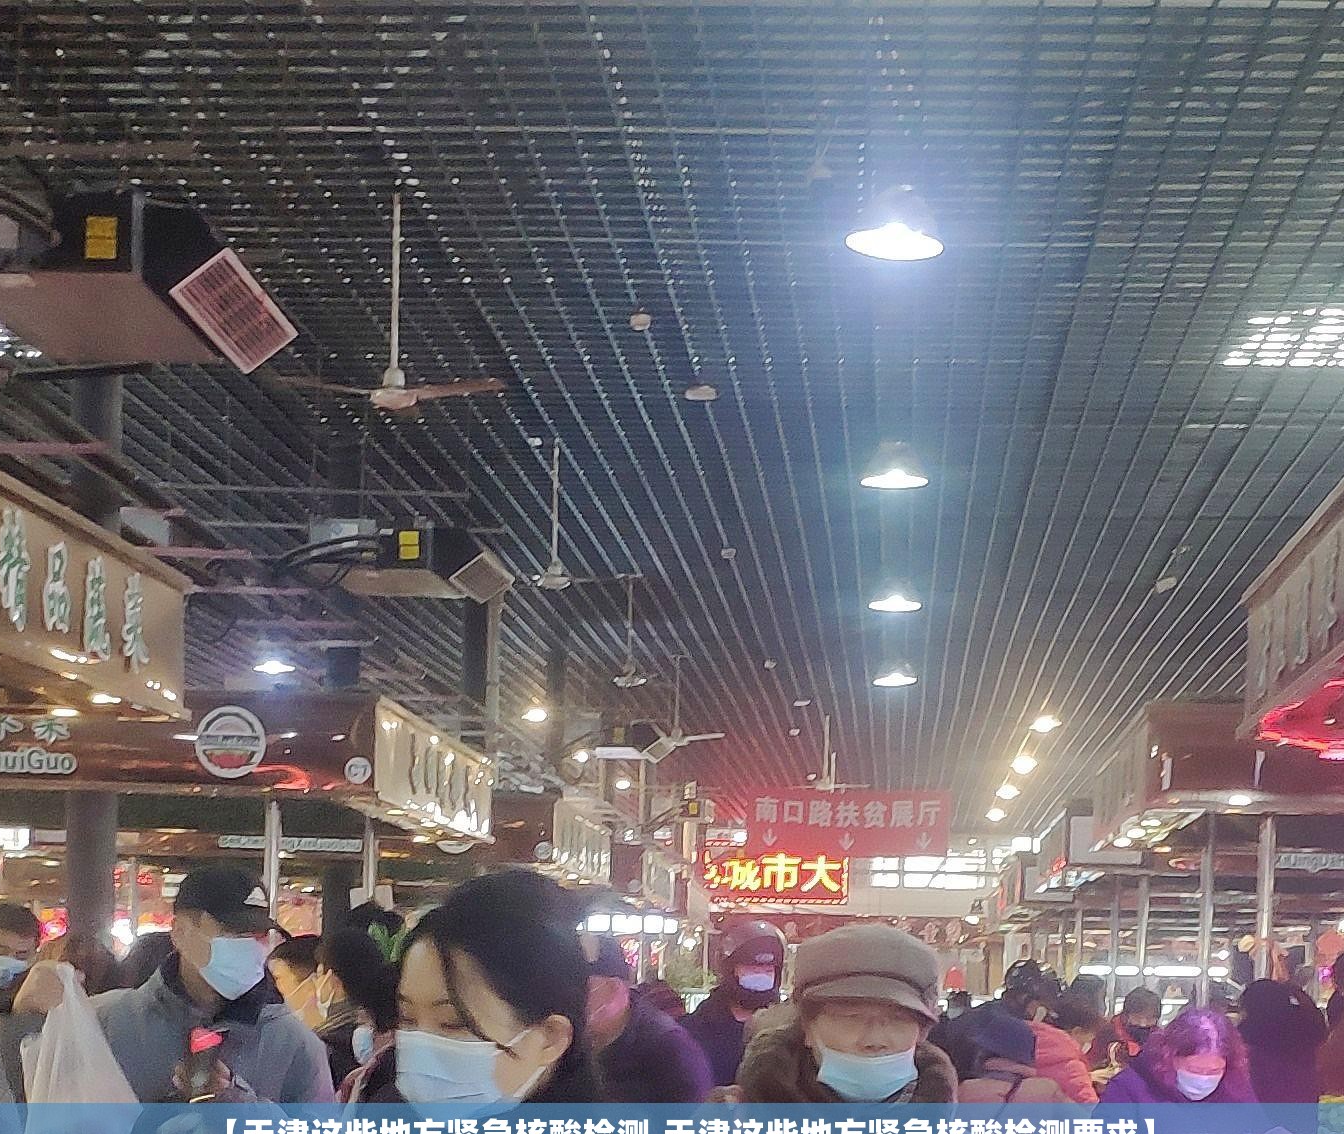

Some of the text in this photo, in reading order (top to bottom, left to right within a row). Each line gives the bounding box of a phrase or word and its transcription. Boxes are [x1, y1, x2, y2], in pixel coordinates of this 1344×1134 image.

[756, 796, 942, 828] 南口路扶贫展厅
